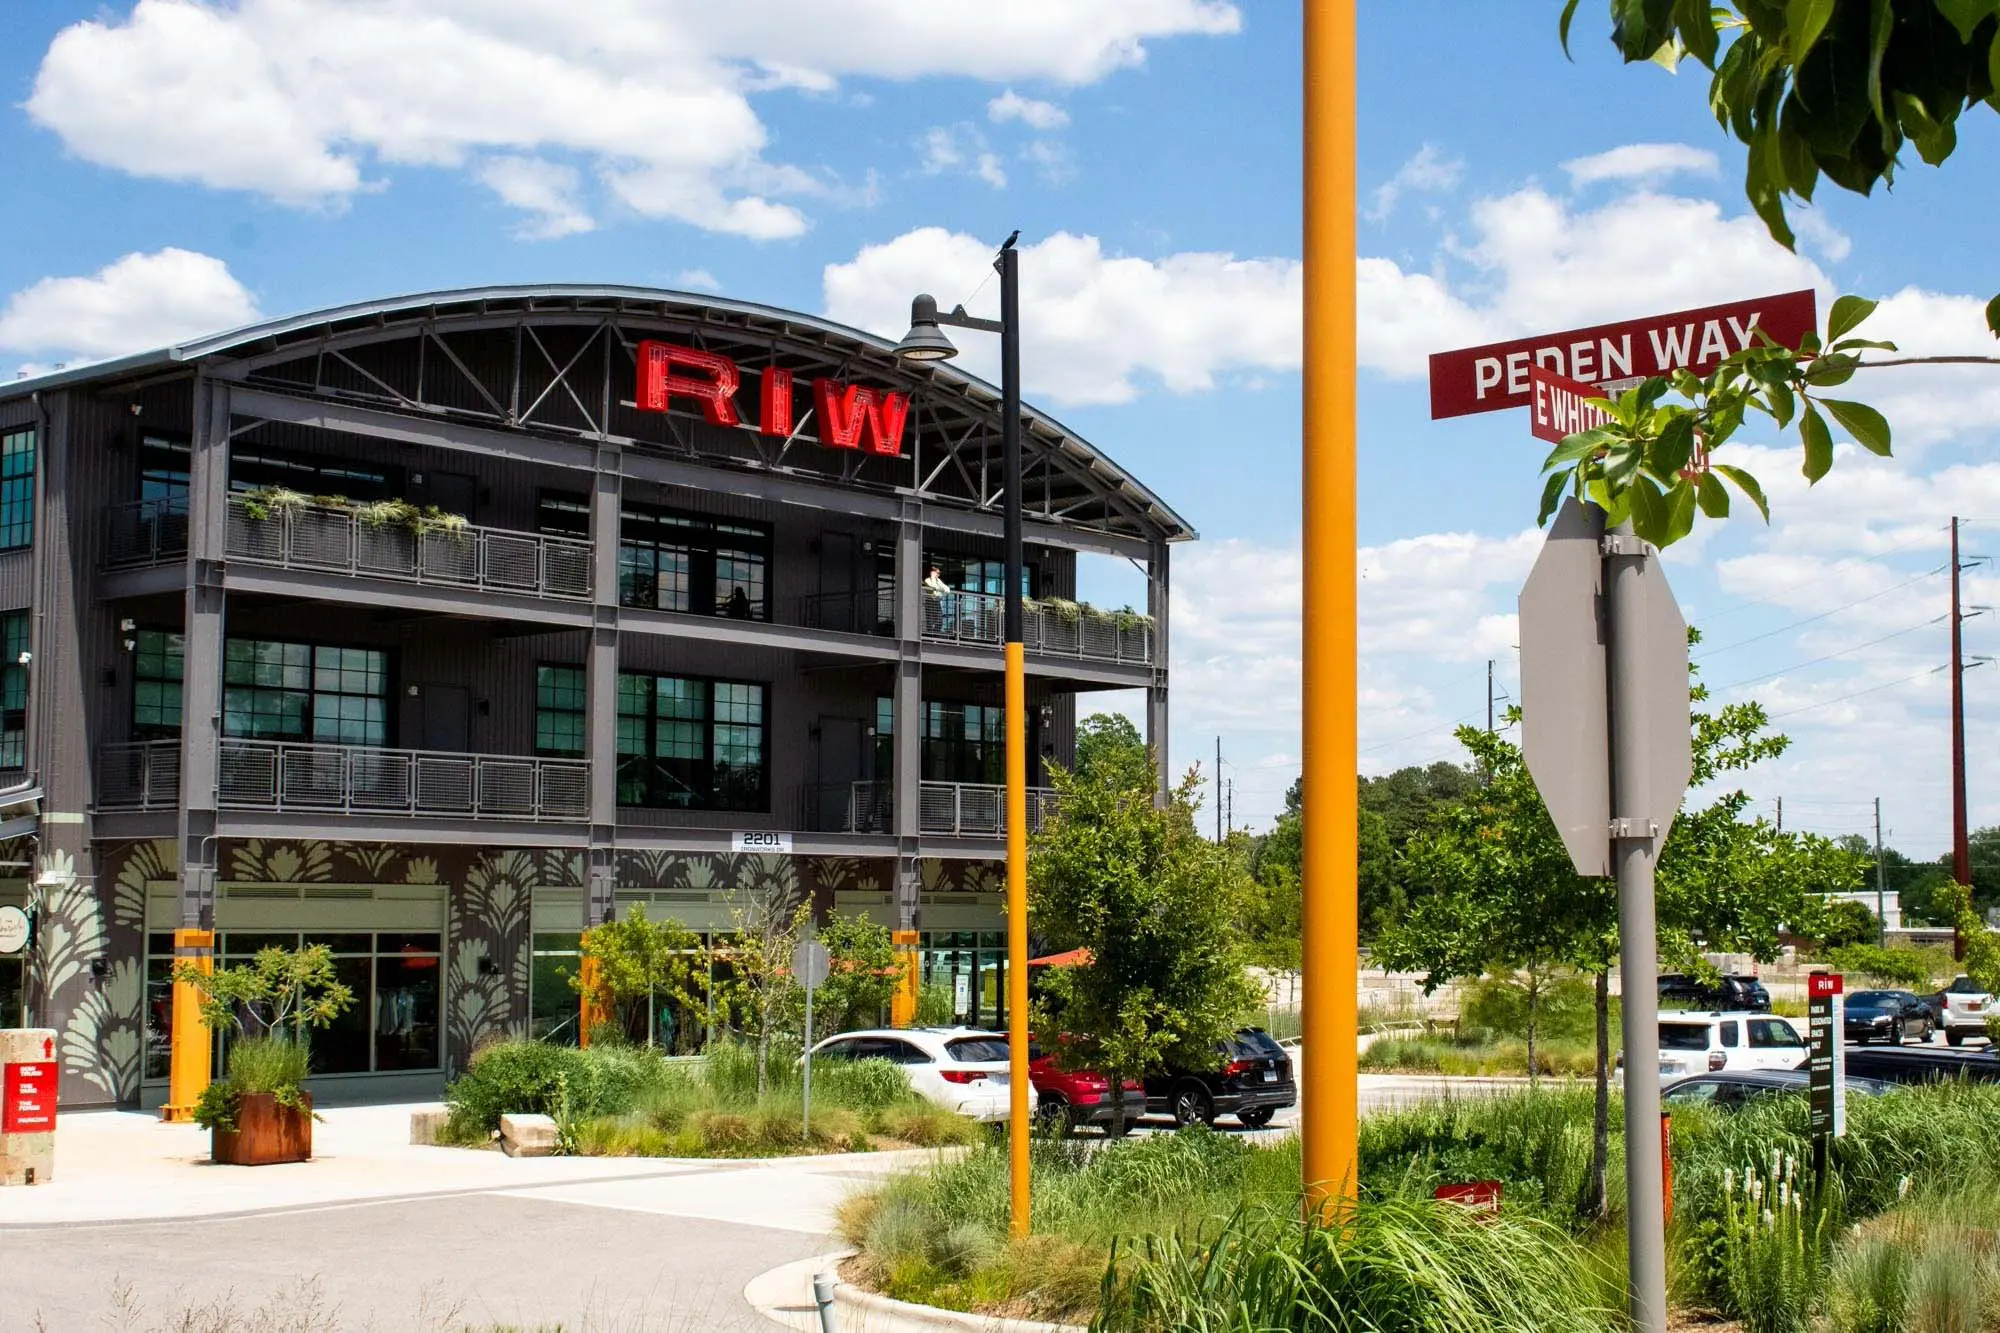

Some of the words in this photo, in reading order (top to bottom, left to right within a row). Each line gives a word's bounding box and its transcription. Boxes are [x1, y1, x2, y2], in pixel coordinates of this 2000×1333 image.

[1474, 334, 1633, 400] PEDEN
[1648, 312, 1761, 371] WAY
[636, 340, 910, 456] RIW
[1536, 380, 1548, 426] E
[744, 832, 781, 845] 2201
